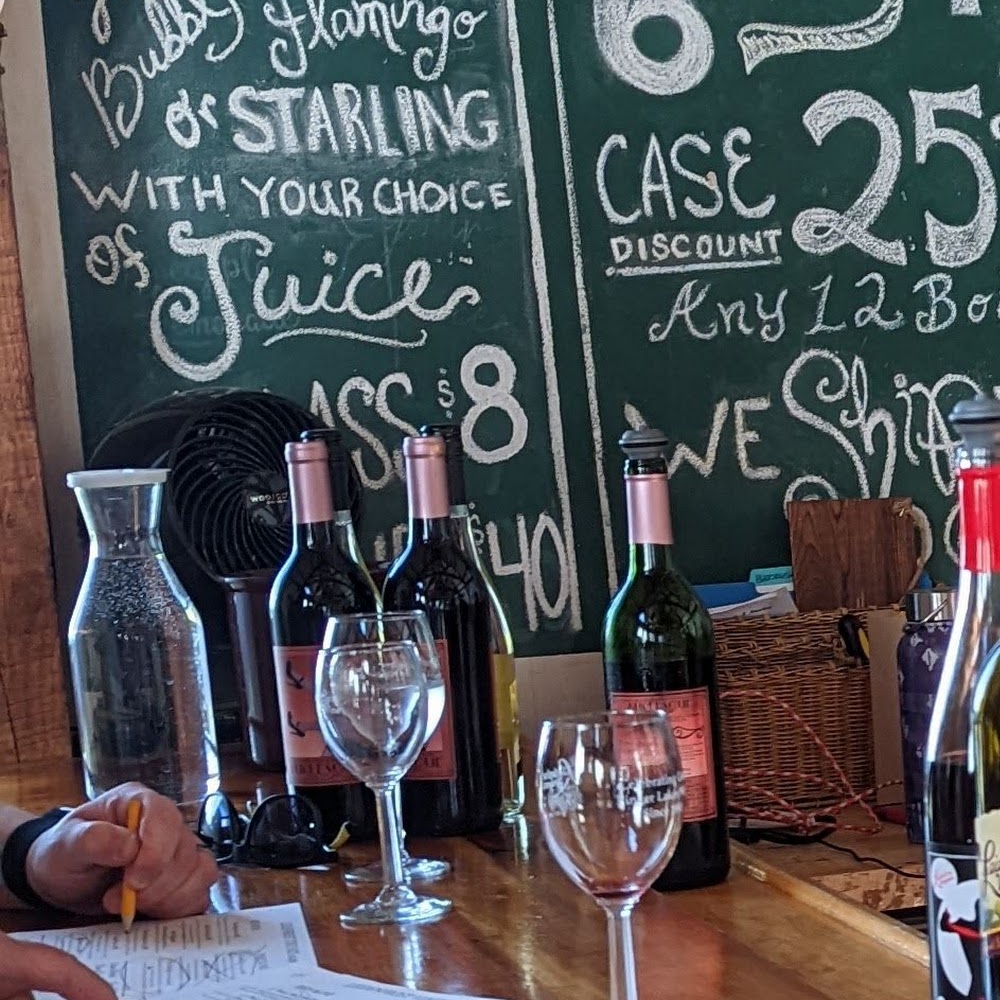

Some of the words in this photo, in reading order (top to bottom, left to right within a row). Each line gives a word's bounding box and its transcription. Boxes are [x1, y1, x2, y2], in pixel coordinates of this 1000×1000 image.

[227, 82, 499, 158] STARLING
[70, 168, 226, 213] WITH
[241, 176, 364, 218] YOUR
[373, 177, 512, 215] CHOICE
[596, 126, 777, 226] CASE
[610, 227, 783, 264] DISCOUNT
[150, 220, 481, 382] Juice
[648, 281, 788, 343] Any
[803, 271, 906, 336] 12
